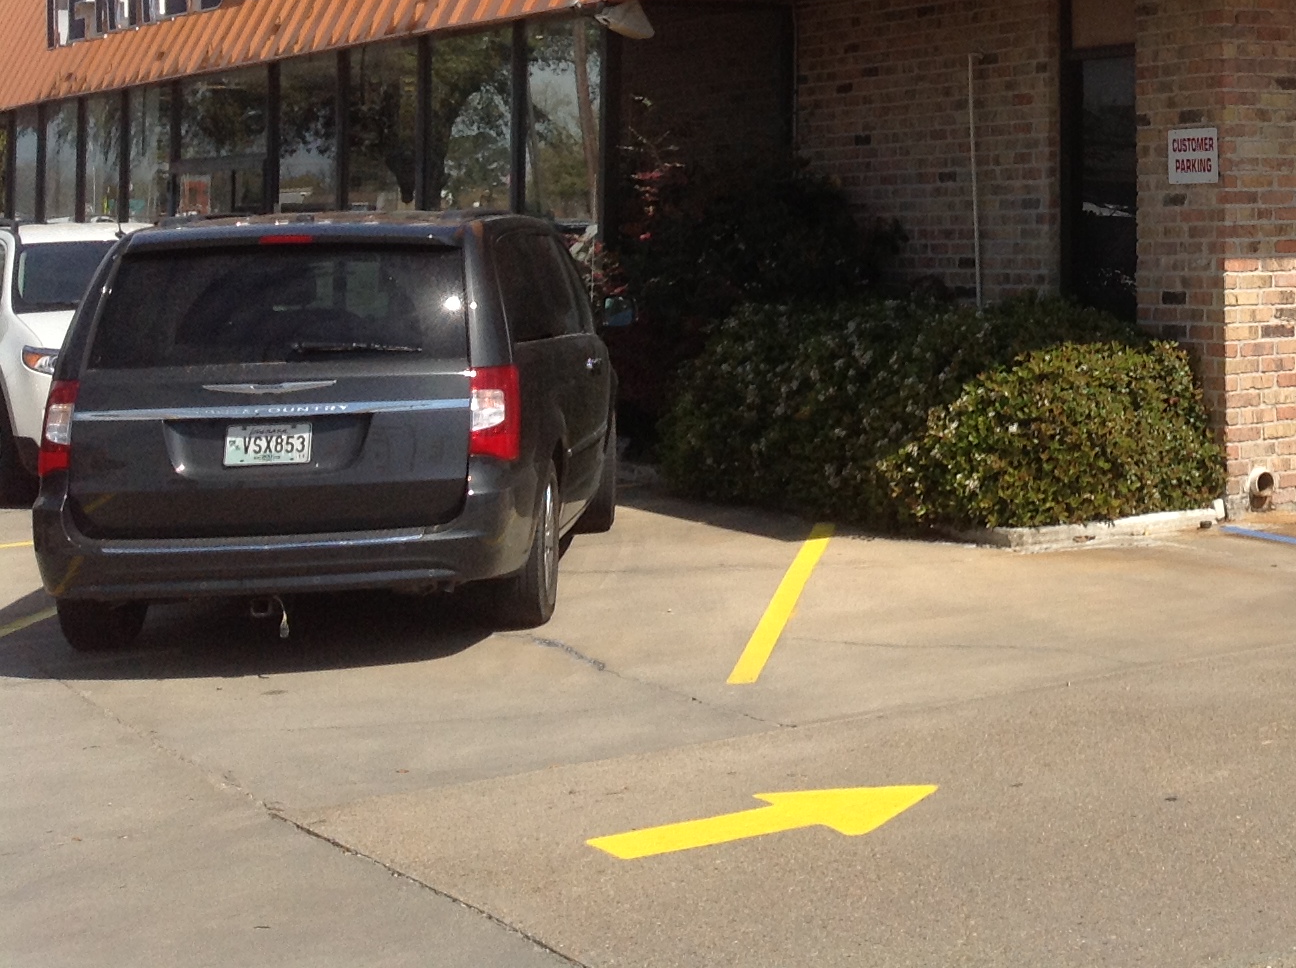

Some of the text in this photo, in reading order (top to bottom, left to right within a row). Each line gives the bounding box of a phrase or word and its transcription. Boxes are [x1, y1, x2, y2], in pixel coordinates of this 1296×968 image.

[1172, 137, 1214, 152] CUSTOMER
[1175, 158, 1212, 173] PARKING
[243, 435, 306, 454] VSX853
